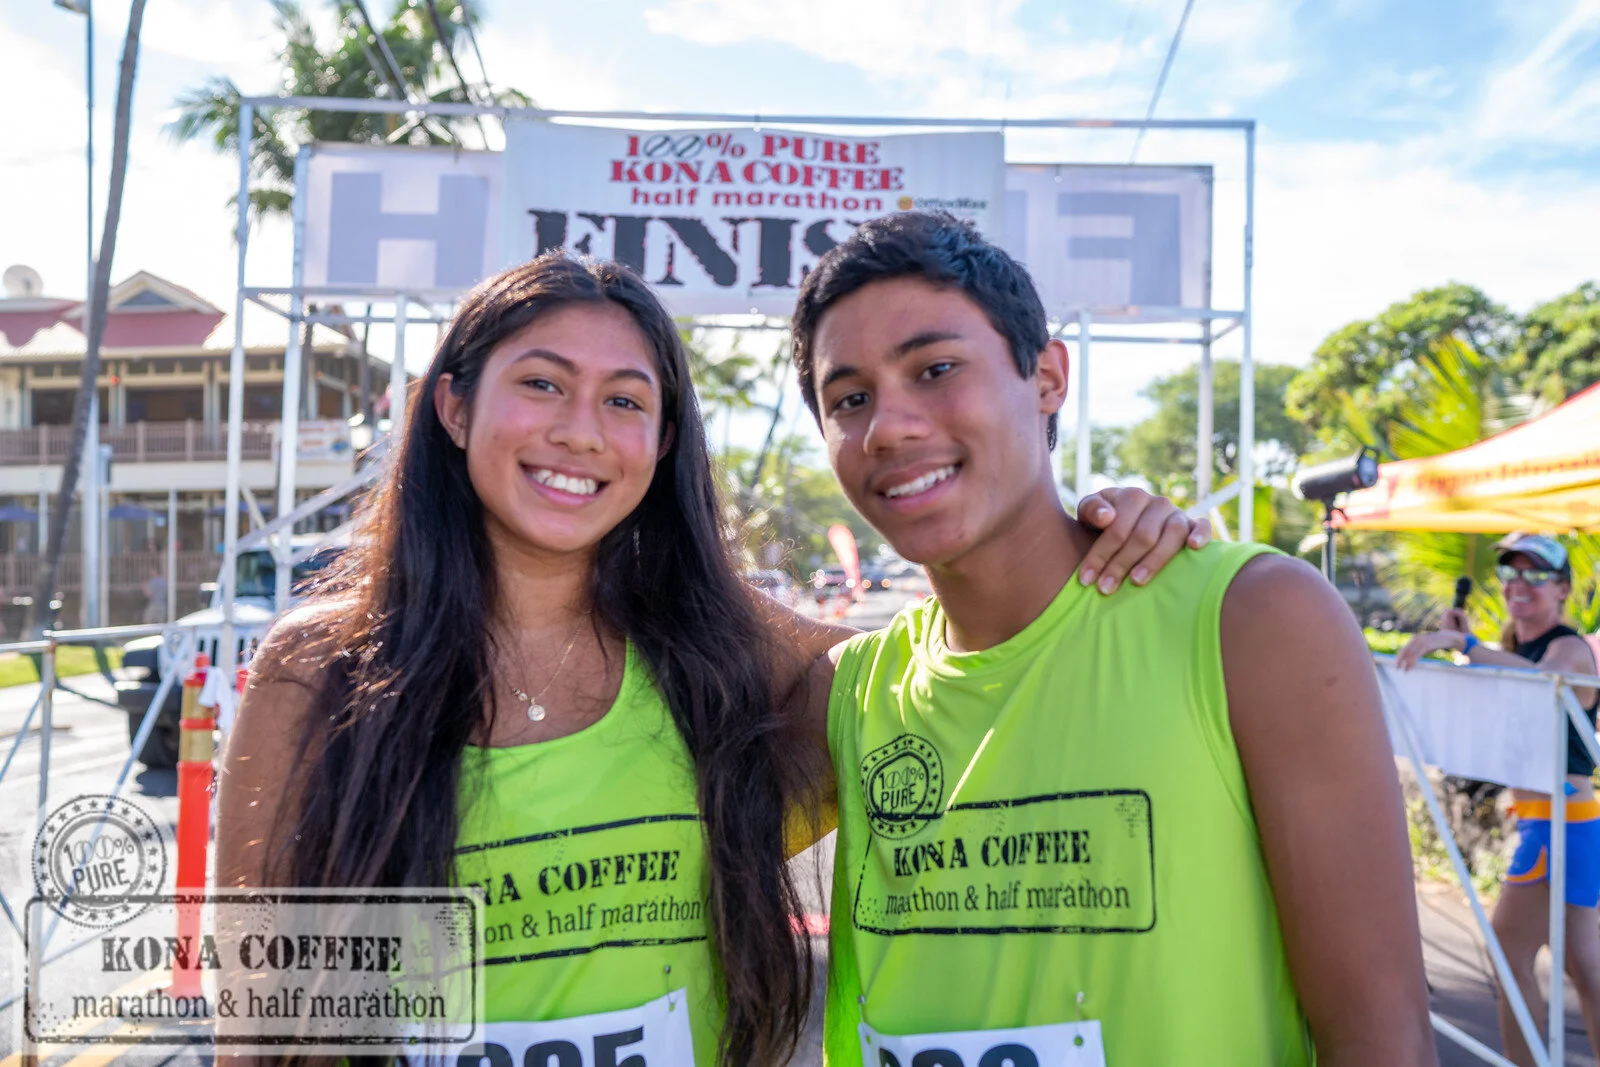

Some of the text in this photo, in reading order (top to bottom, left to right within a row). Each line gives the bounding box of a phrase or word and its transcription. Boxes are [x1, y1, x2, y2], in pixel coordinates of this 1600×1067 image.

[626, 133, 880, 165] 100% PURE
[610, 159, 904, 191] KONA COFFEE
[631, 187, 883, 212] half marathon
[528, 208, 863, 290] FINIS
[879, 766, 925, 790] 100%
[881, 783, 918, 811] PURE
[894, 830, 1091, 877] KONA COFFEE
[539, 850, 680, 895] COFFEE
[885, 880, 1131, 915] maathon & half marathon
[522, 914, 540, 938] &
[547, 903, 597, 935] half
[600, 896, 701, 928] marathon
